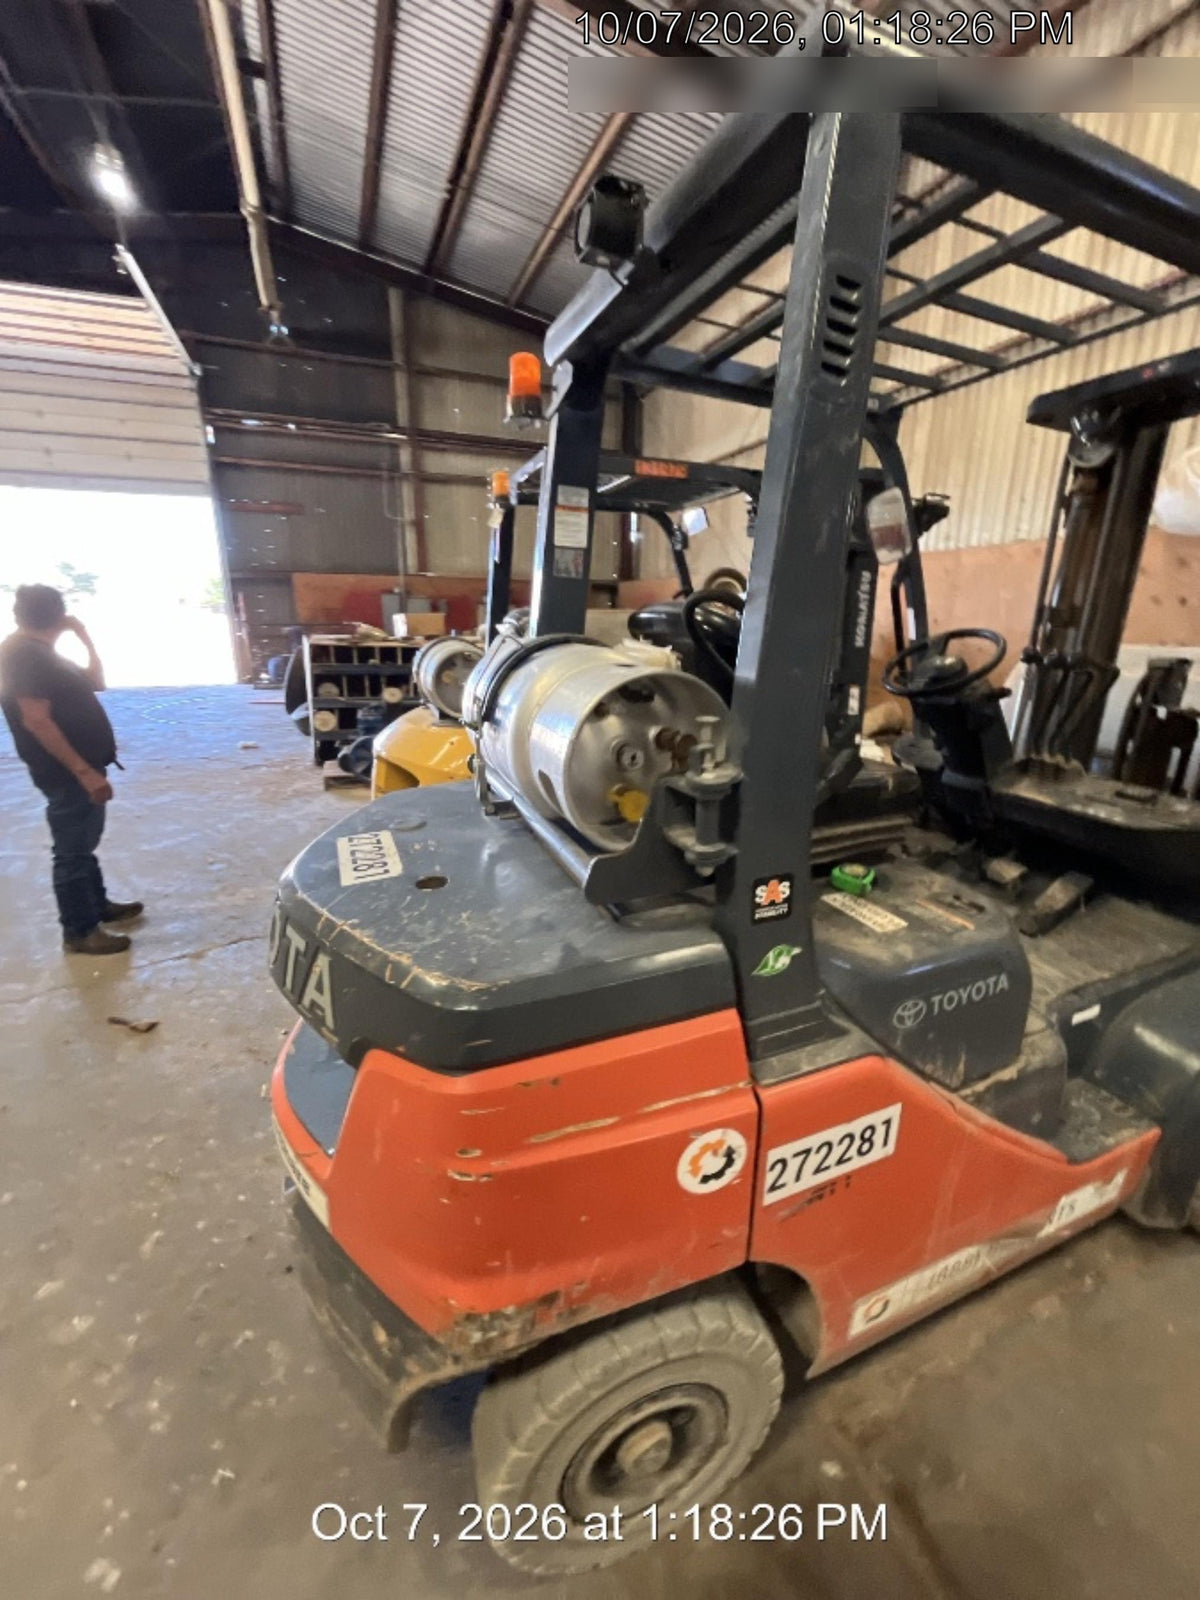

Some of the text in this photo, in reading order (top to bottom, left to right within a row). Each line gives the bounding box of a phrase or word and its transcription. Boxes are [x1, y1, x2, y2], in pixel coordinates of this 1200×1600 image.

[754, 879, 791, 906] SAS
[931, 972, 1009, 1016] TOYOTA
[766, 1117, 893, 1195] 272281
